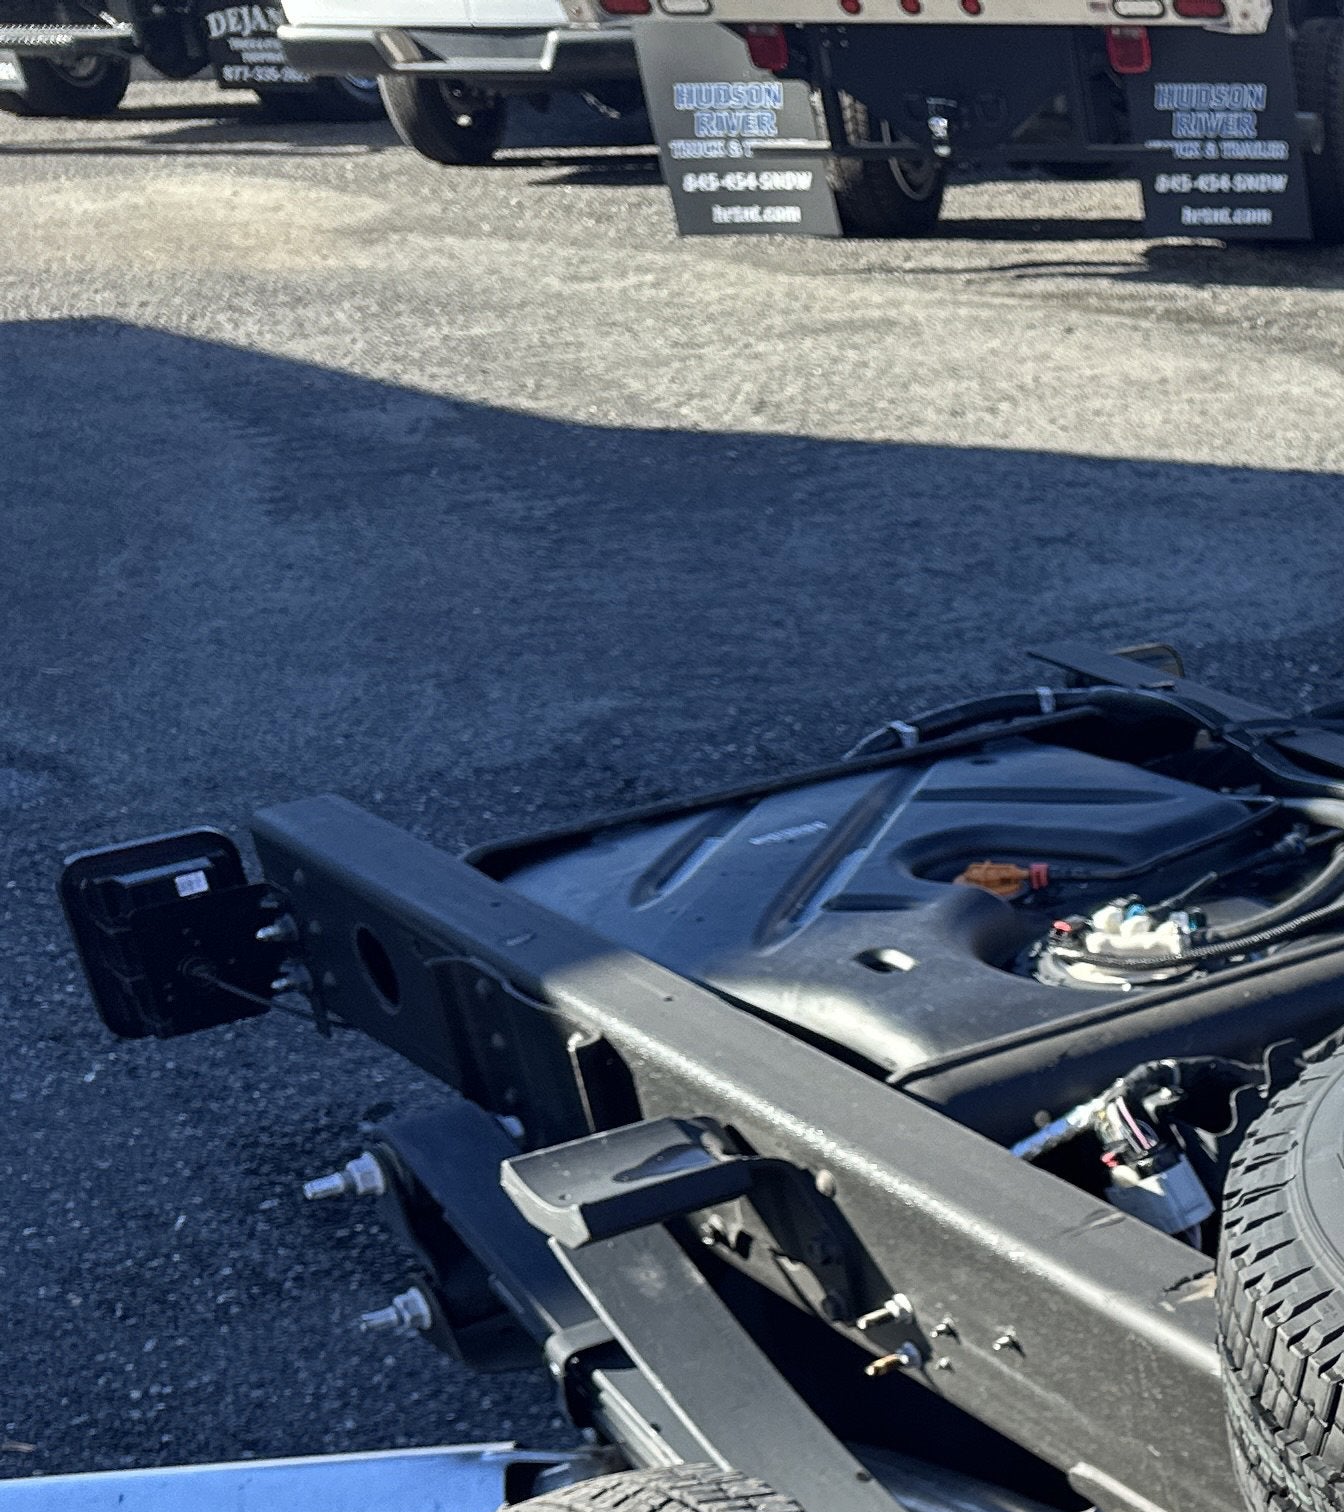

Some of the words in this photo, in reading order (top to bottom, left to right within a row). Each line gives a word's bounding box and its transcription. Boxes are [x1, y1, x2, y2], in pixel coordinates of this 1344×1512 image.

[673, 82, 784, 110] HUDSON
[1154, 83, 1267, 111] HUDSON
[694, 110, 778, 137] RIVER
[1172, 111, 1257, 138] RIVER
[668, 139, 726, 159] TRUCK
